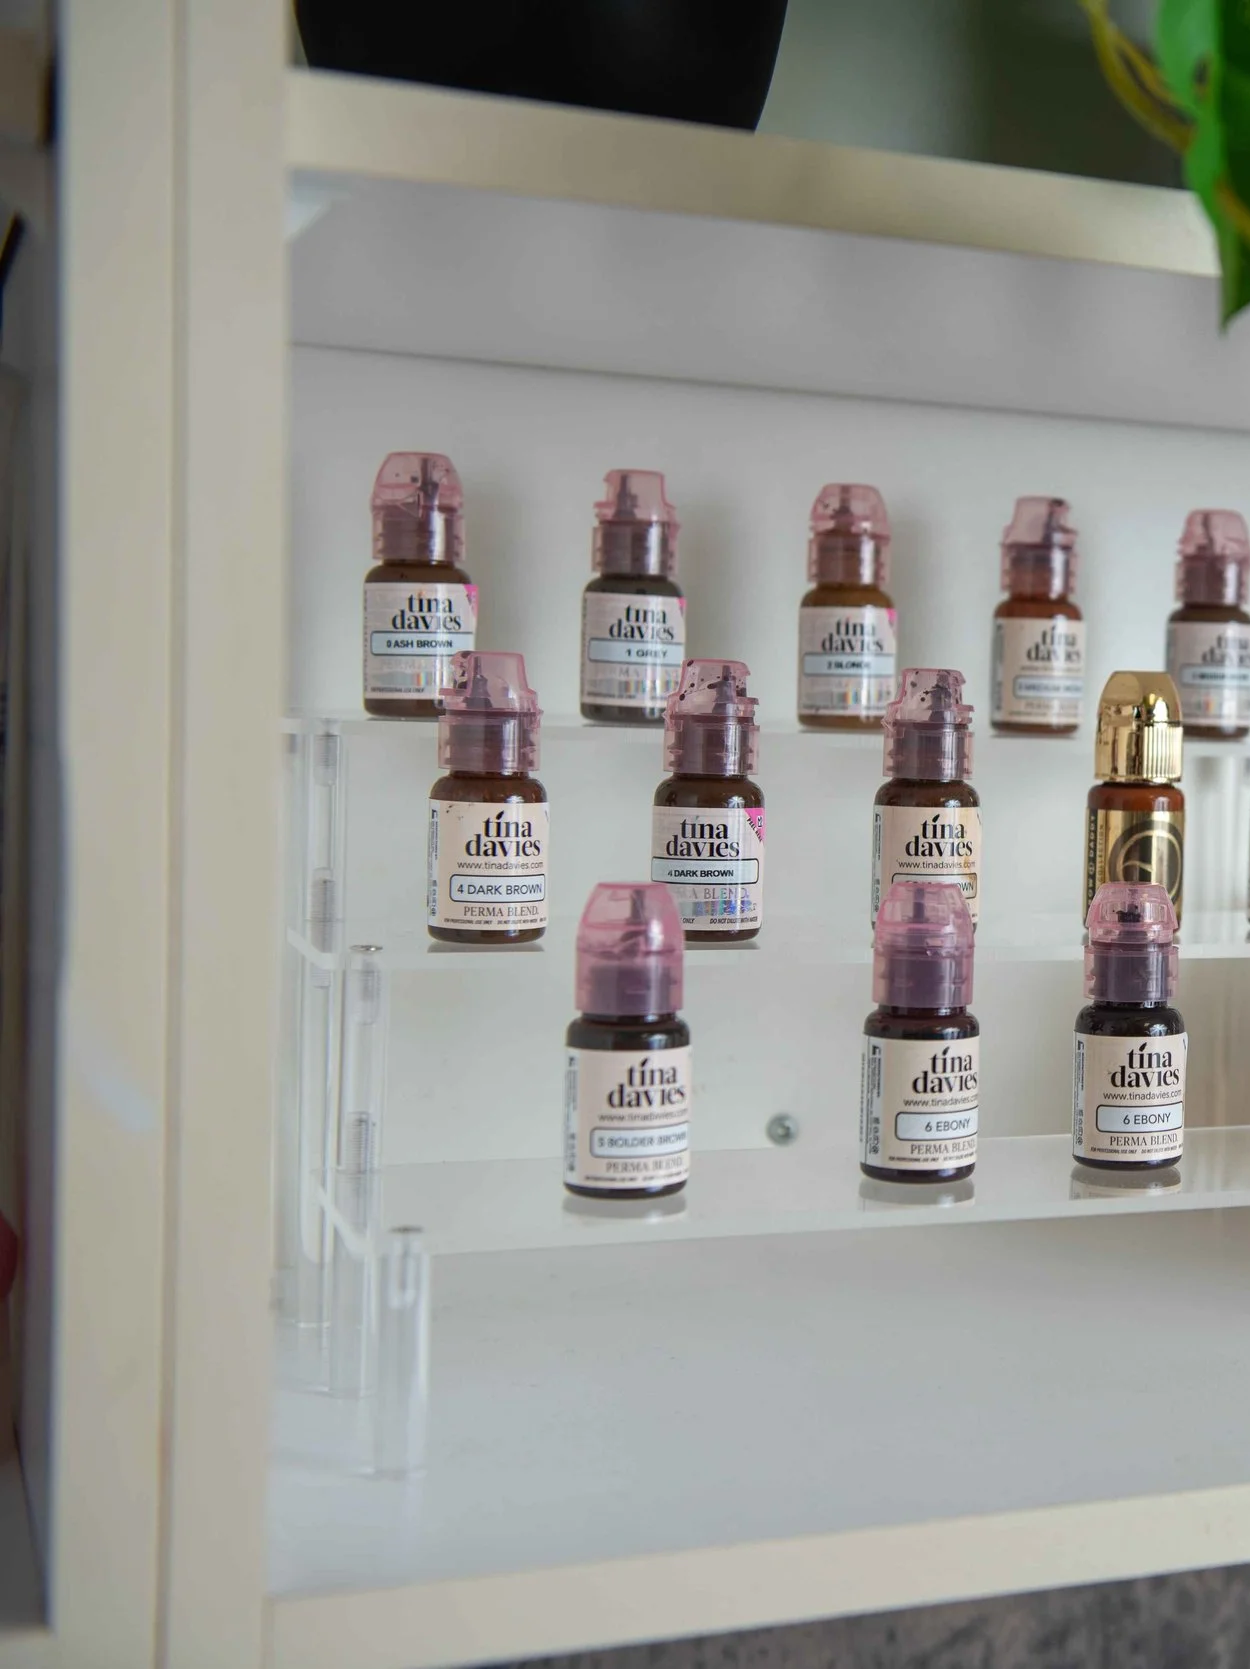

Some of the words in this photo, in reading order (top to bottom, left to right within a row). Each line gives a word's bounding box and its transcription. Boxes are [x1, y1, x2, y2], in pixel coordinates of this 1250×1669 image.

[392, 609, 462, 631] davies
[608, 618, 674, 641] davies
[393, 640, 414, 649] ASH
[416, 640, 453, 649] BROWN
[465, 833, 541, 857] davies
[666, 835, 740, 857] davies
[905, 835, 973, 857] davies
[457, 862, 544, 870] www.tinadavies.com
[457, 884, 464, 894] 4
[467, 884, 502, 895] DARK
[505, 883, 542, 895] BROWN
[463, 906, 504, 917] PERMA
[912, 1070, 978, 1094] davies
[1110, 1065, 1179, 1088] davies
[607, 1083, 686, 1108] davies
[924, 1122, 932, 1132] 6
[936, 1118, 970, 1132] EBONY
[1123, 1115, 1130, 1125] 6
[1133, 1112, 1171, 1125] EBONY
[607, 1136, 654, 1148] BOLDER
[1109, 1136, 1147, 1146] PERMA
[910, 1143, 949, 1155] PERMA
[606, 1161, 648, 1173] PERMA
